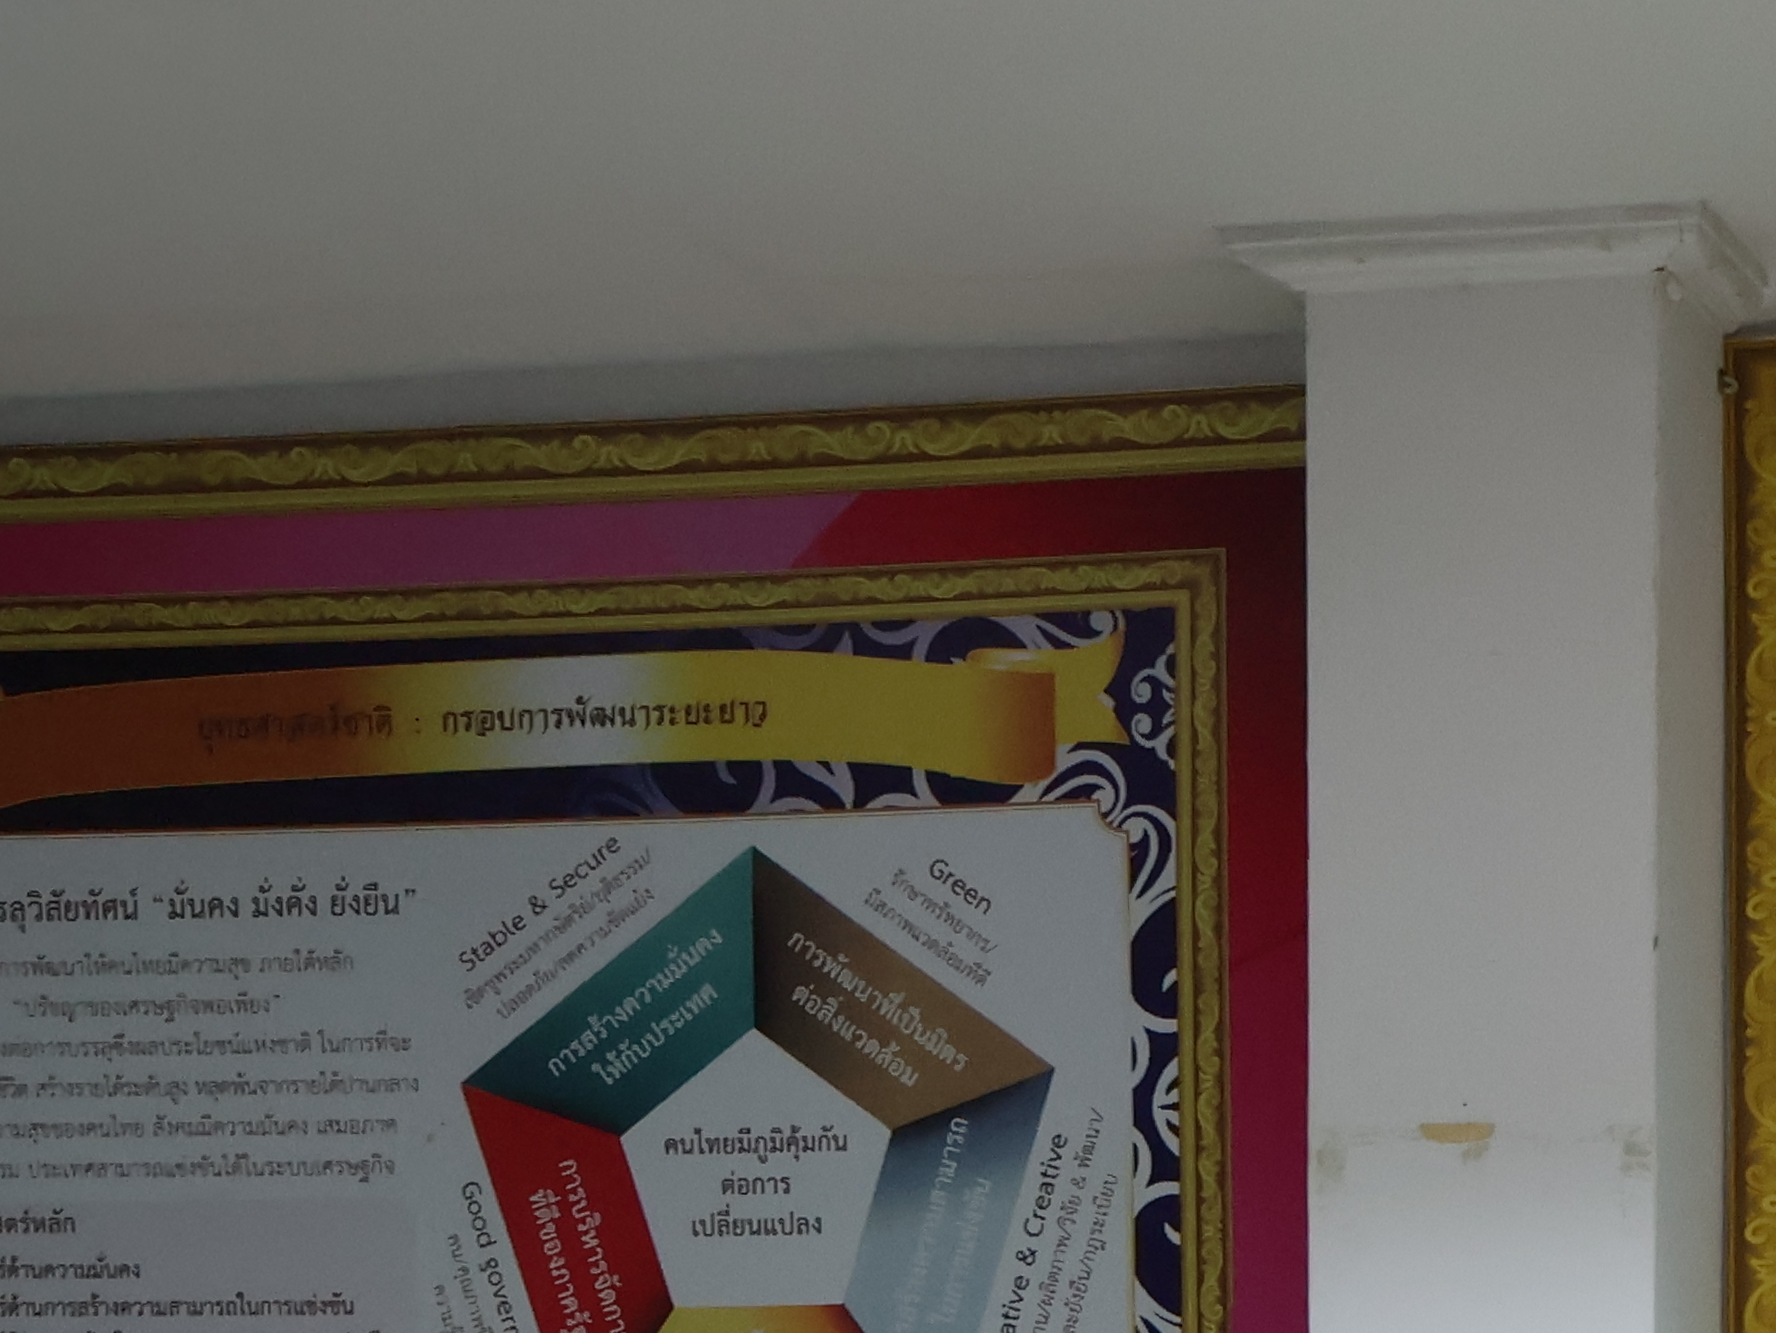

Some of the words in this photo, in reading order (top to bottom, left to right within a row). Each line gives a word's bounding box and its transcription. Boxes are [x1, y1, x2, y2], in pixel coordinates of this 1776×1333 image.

[441, 695, 769, 737] กรอบการพัฒนาระยะยาว
[458, 911, 528, 973] Stable
[527, 894, 549, 918] &
[548, 834, 622, 900] Secure
[927, 856, 993, 916] Green
[547, 927, 725, 1078] การสร้างความมั่นคง
[791, 983, 920, 1088] ต่อสิ่งแวดล้อม
[663, 1126, 848, 1164] คนไทยมีภูมิคุ้มกัน
[719, 1170, 792, 1197] ต่อการ
[1023, 1131, 1068, 1237] Creative
[460, 1180, 497, 1250] Good
[691, 1204, 823, 1239] เปลี่ยนแปลง
[1014, 1244, 1038, 1267] &
